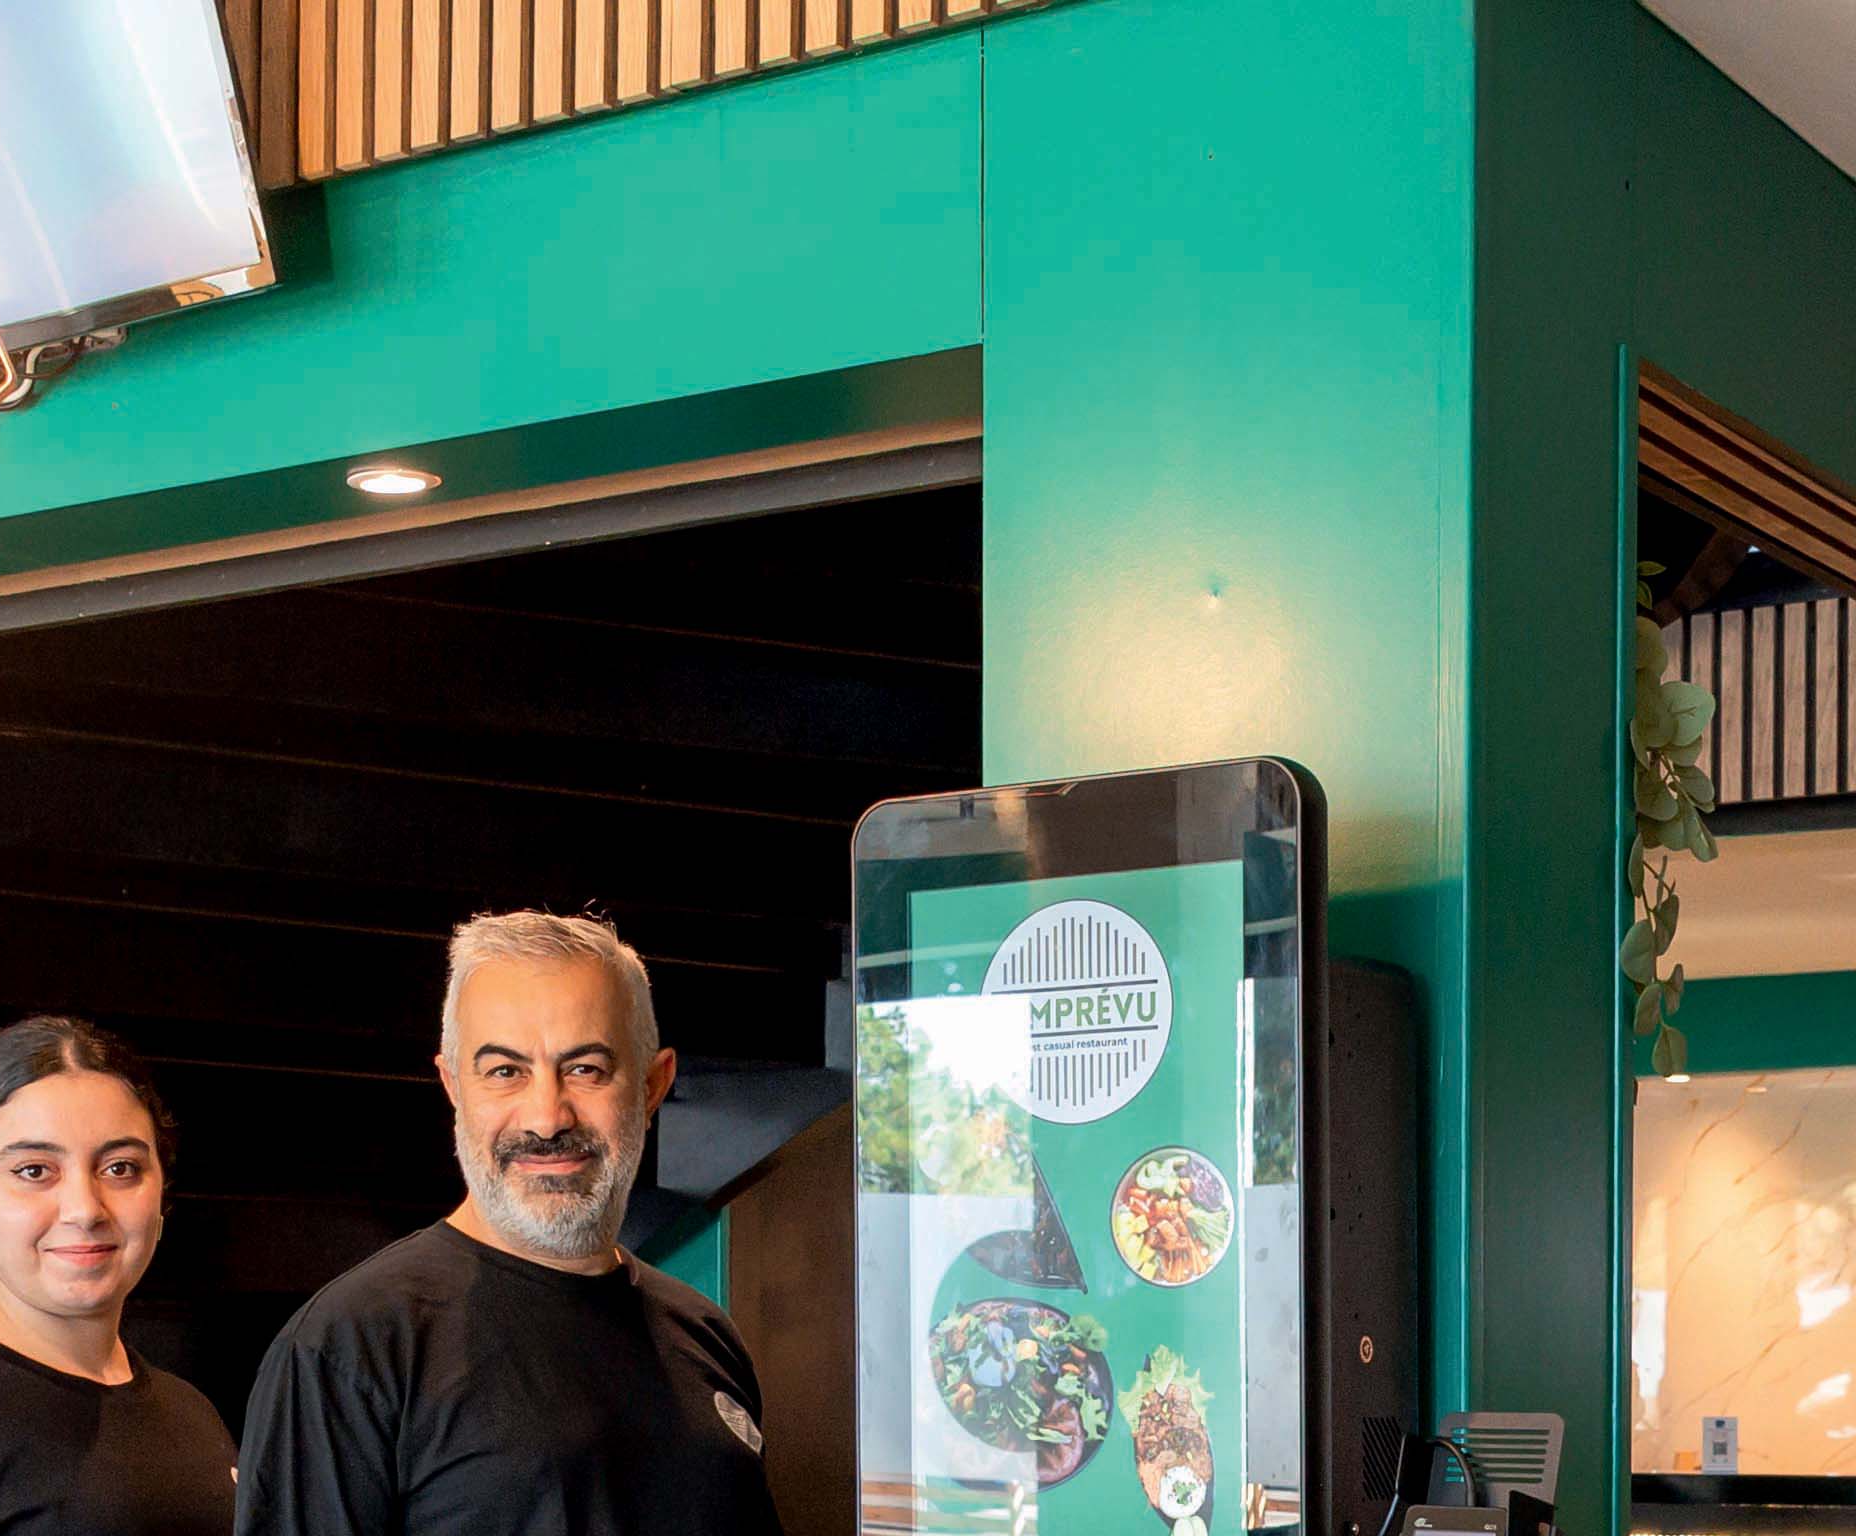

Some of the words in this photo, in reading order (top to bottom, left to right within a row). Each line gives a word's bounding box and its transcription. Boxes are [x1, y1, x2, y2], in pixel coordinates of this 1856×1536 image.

[1030, 988, 1156, 1030] MPRÉVU
[1044, 1040, 1074, 1052] casual
[1076, 1037, 1128, 1049] restaurant
